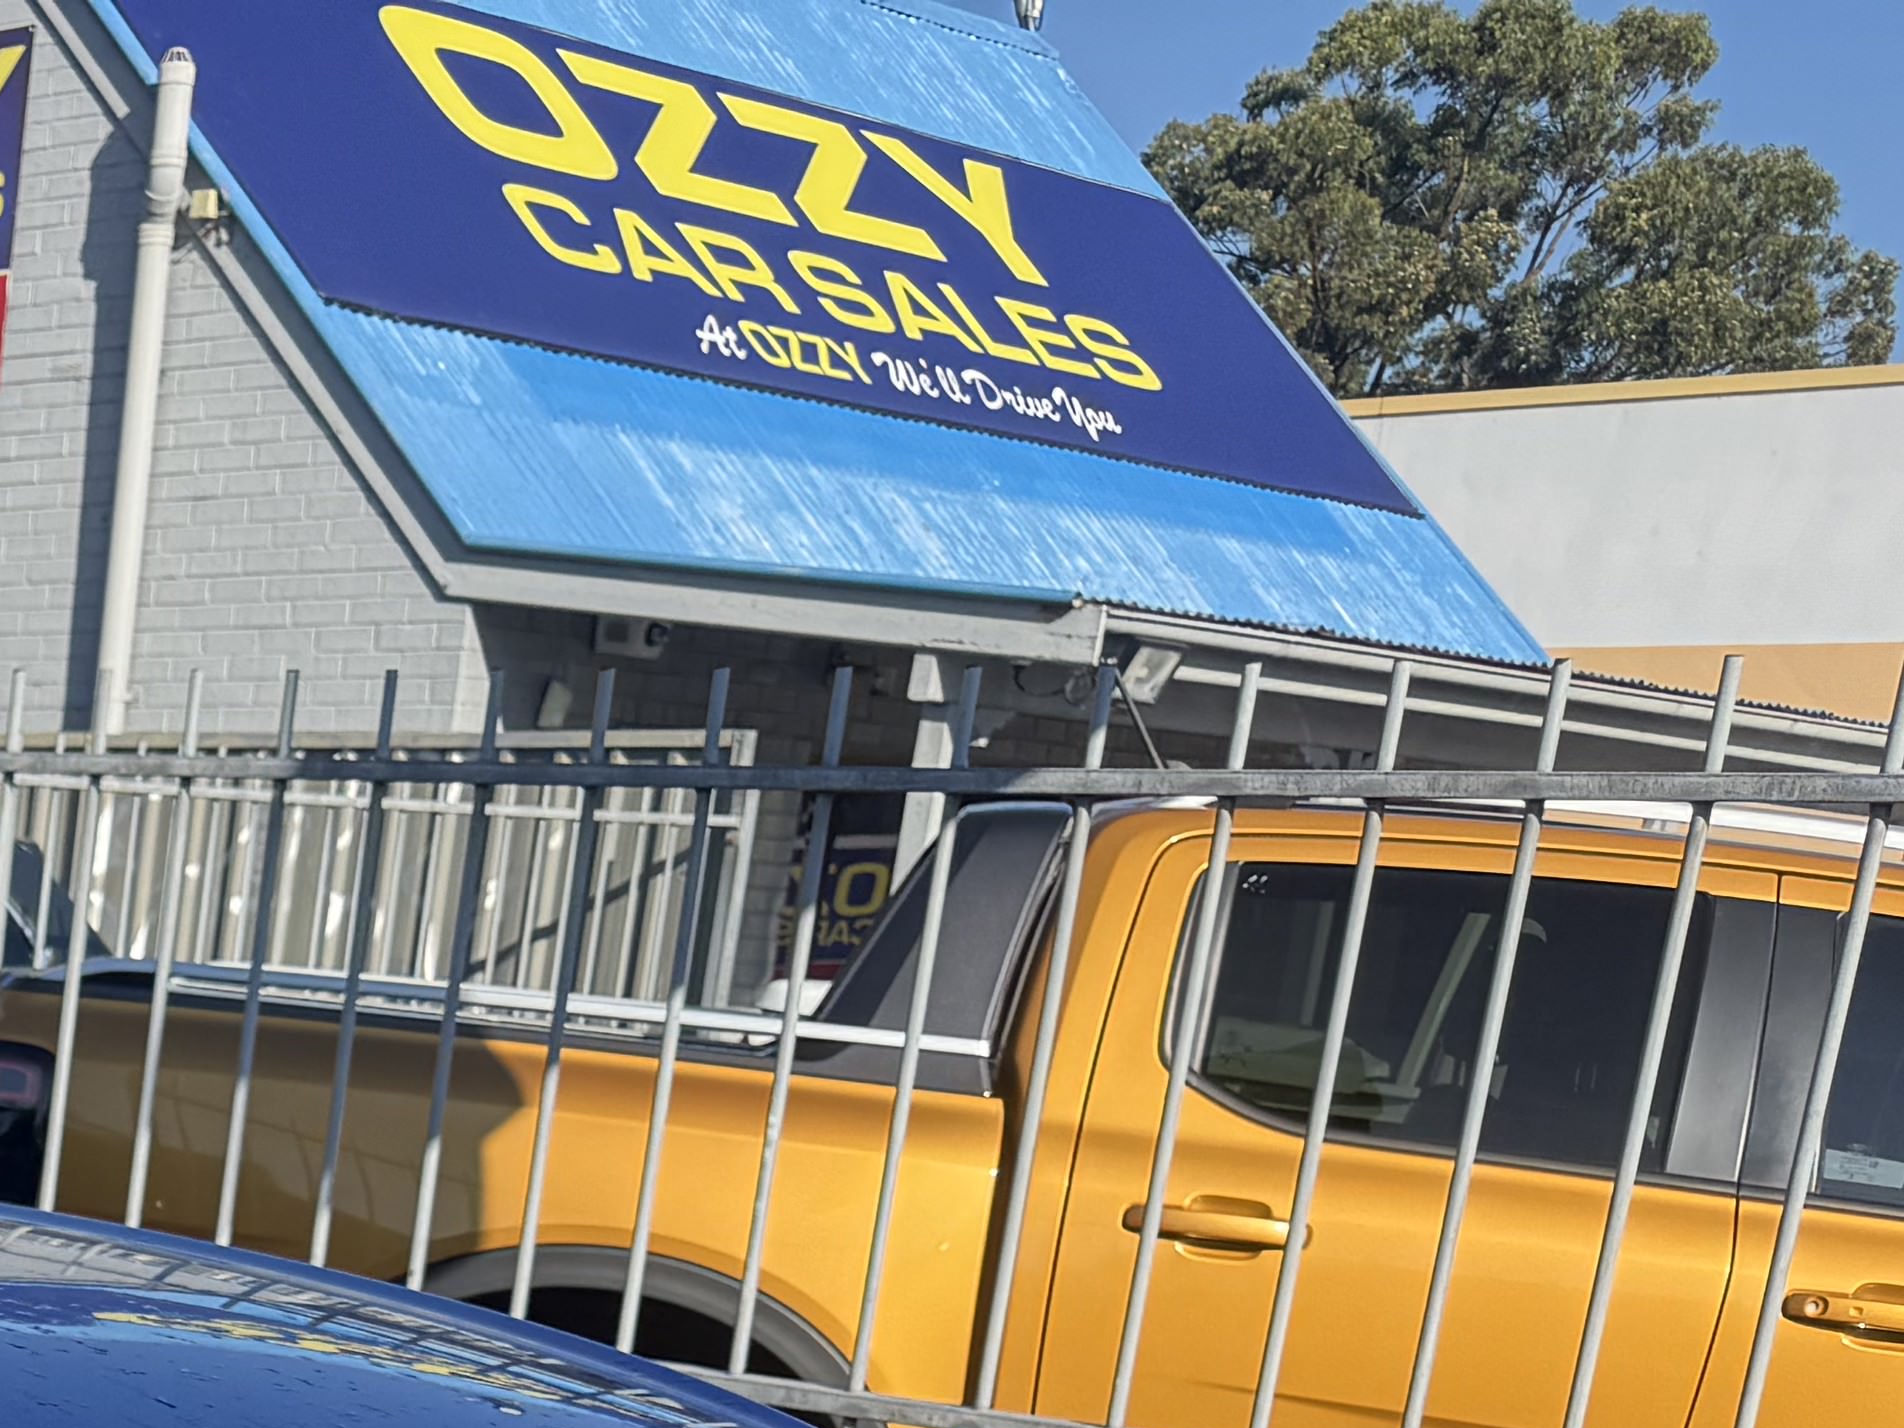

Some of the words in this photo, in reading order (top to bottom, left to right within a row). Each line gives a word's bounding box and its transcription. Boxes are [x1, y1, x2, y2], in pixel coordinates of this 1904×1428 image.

[378, 4, 1048, 287] OZZY
[502, 184, 797, 313] CAR
[788, 250, 1163, 392] SALES
[695, 313, 748, 361] At
[738, 320, 873, 385] OZZY
[960, 368, 1062, 423] Drive
[1050, 386, 1123, 442] You
